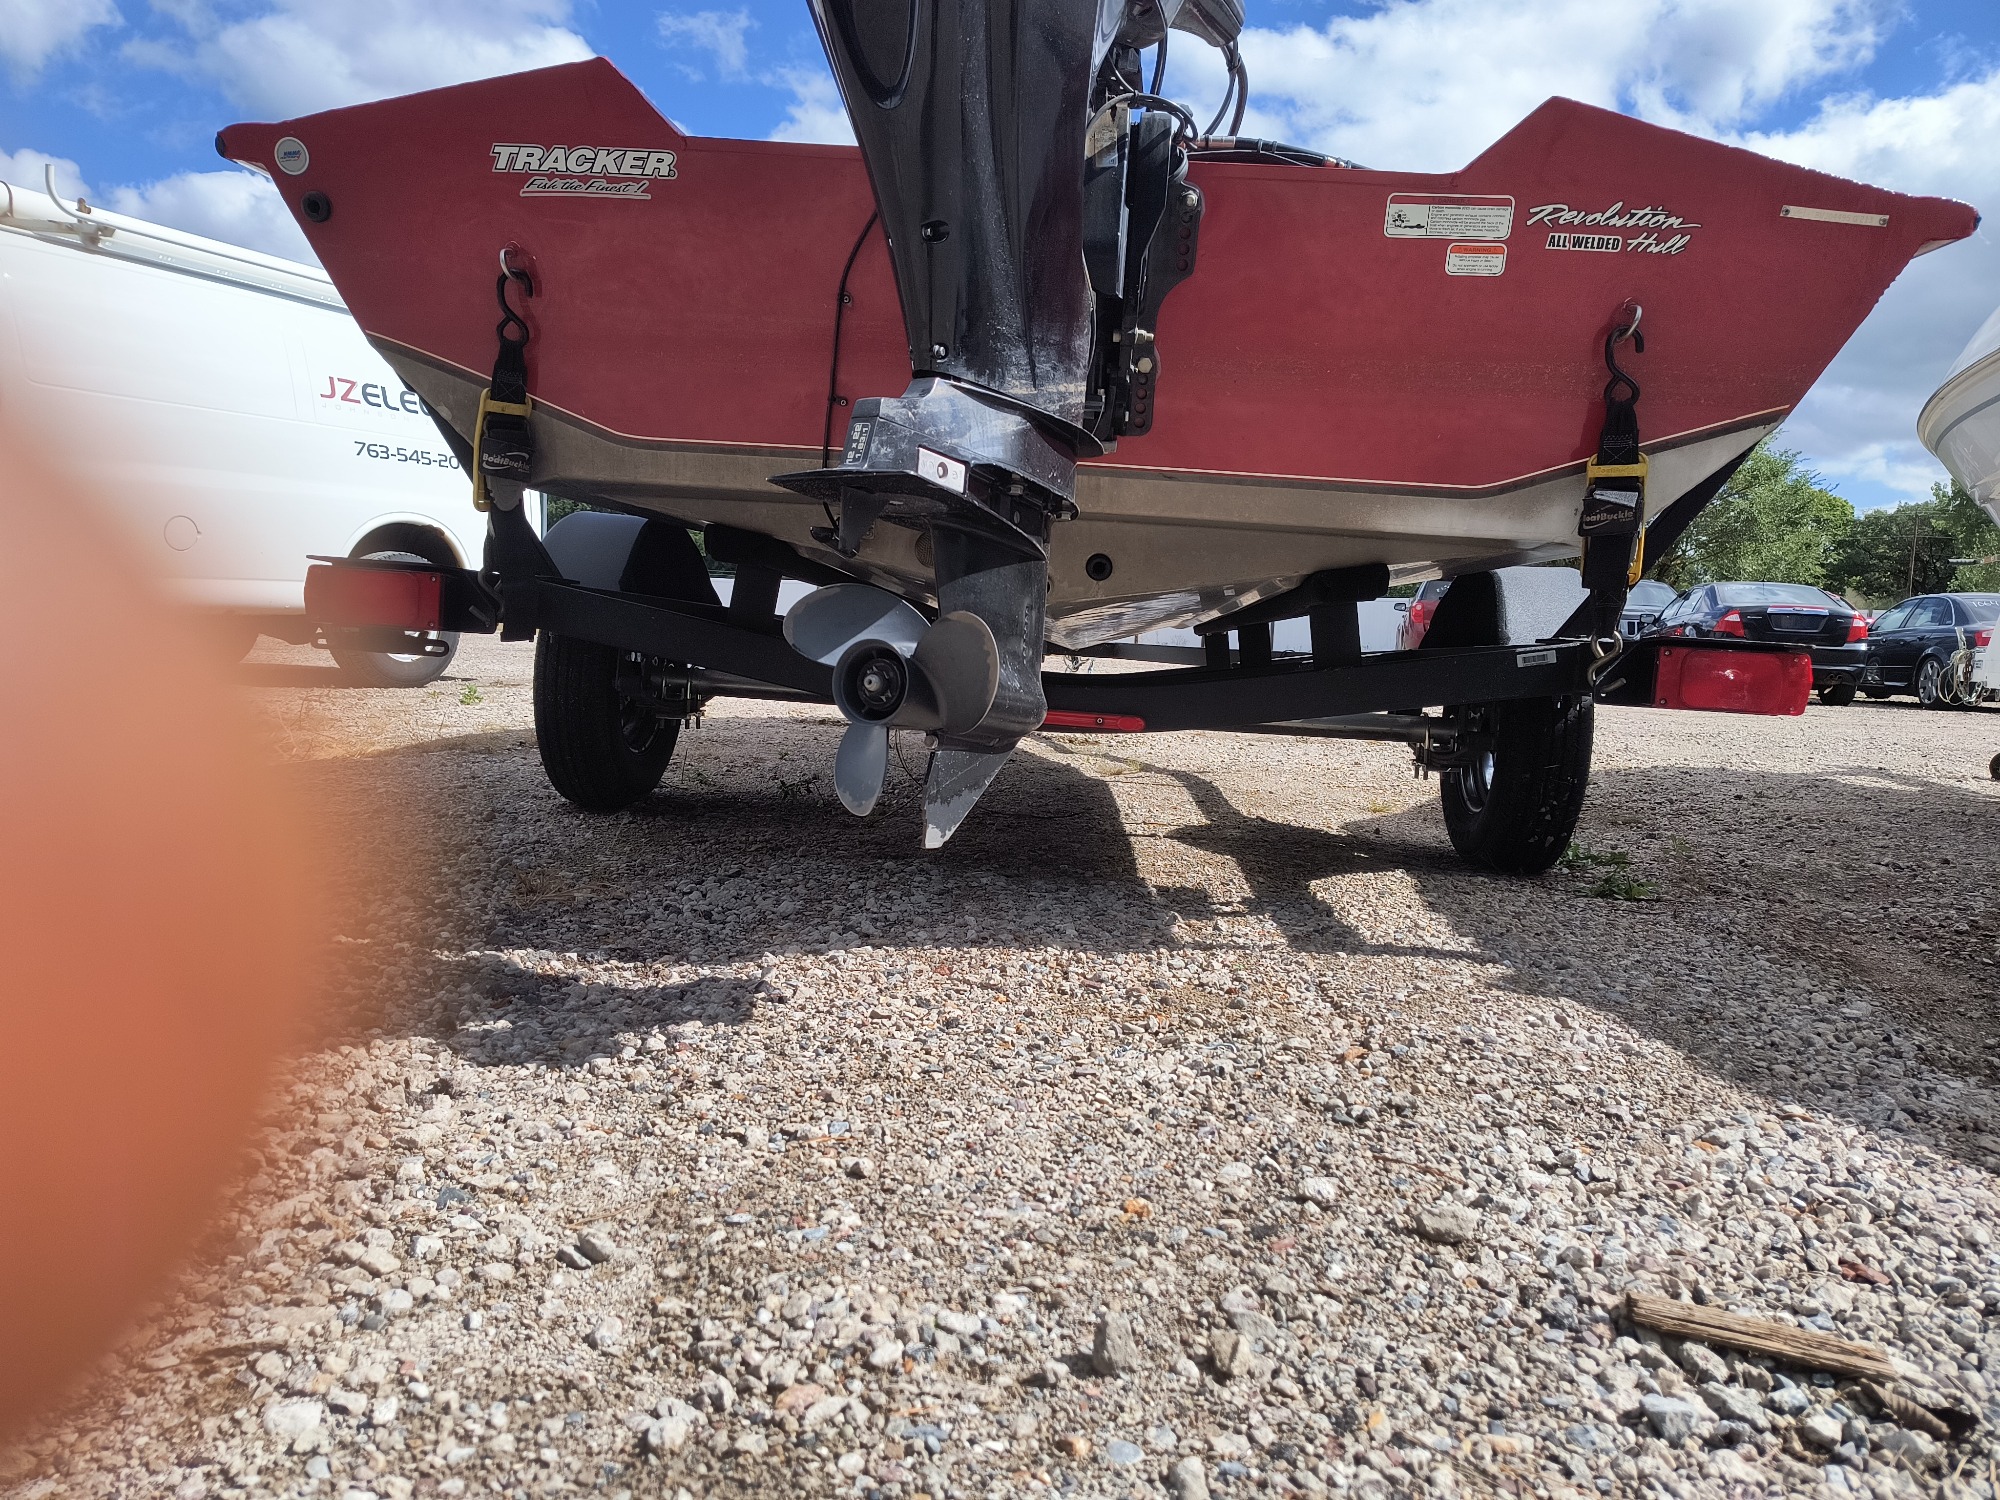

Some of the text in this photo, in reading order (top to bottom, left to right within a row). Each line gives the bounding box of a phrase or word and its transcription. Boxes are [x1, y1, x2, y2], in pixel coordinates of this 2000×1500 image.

[493, 145, 676, 177] TRACKER
[526, 179, 557, 190] Fish
[561, 180, 583, 191] the
[1527, 201, 1701, 229] Revolution
[1548, 233, 1691, 255] ALL WELDED Hull
